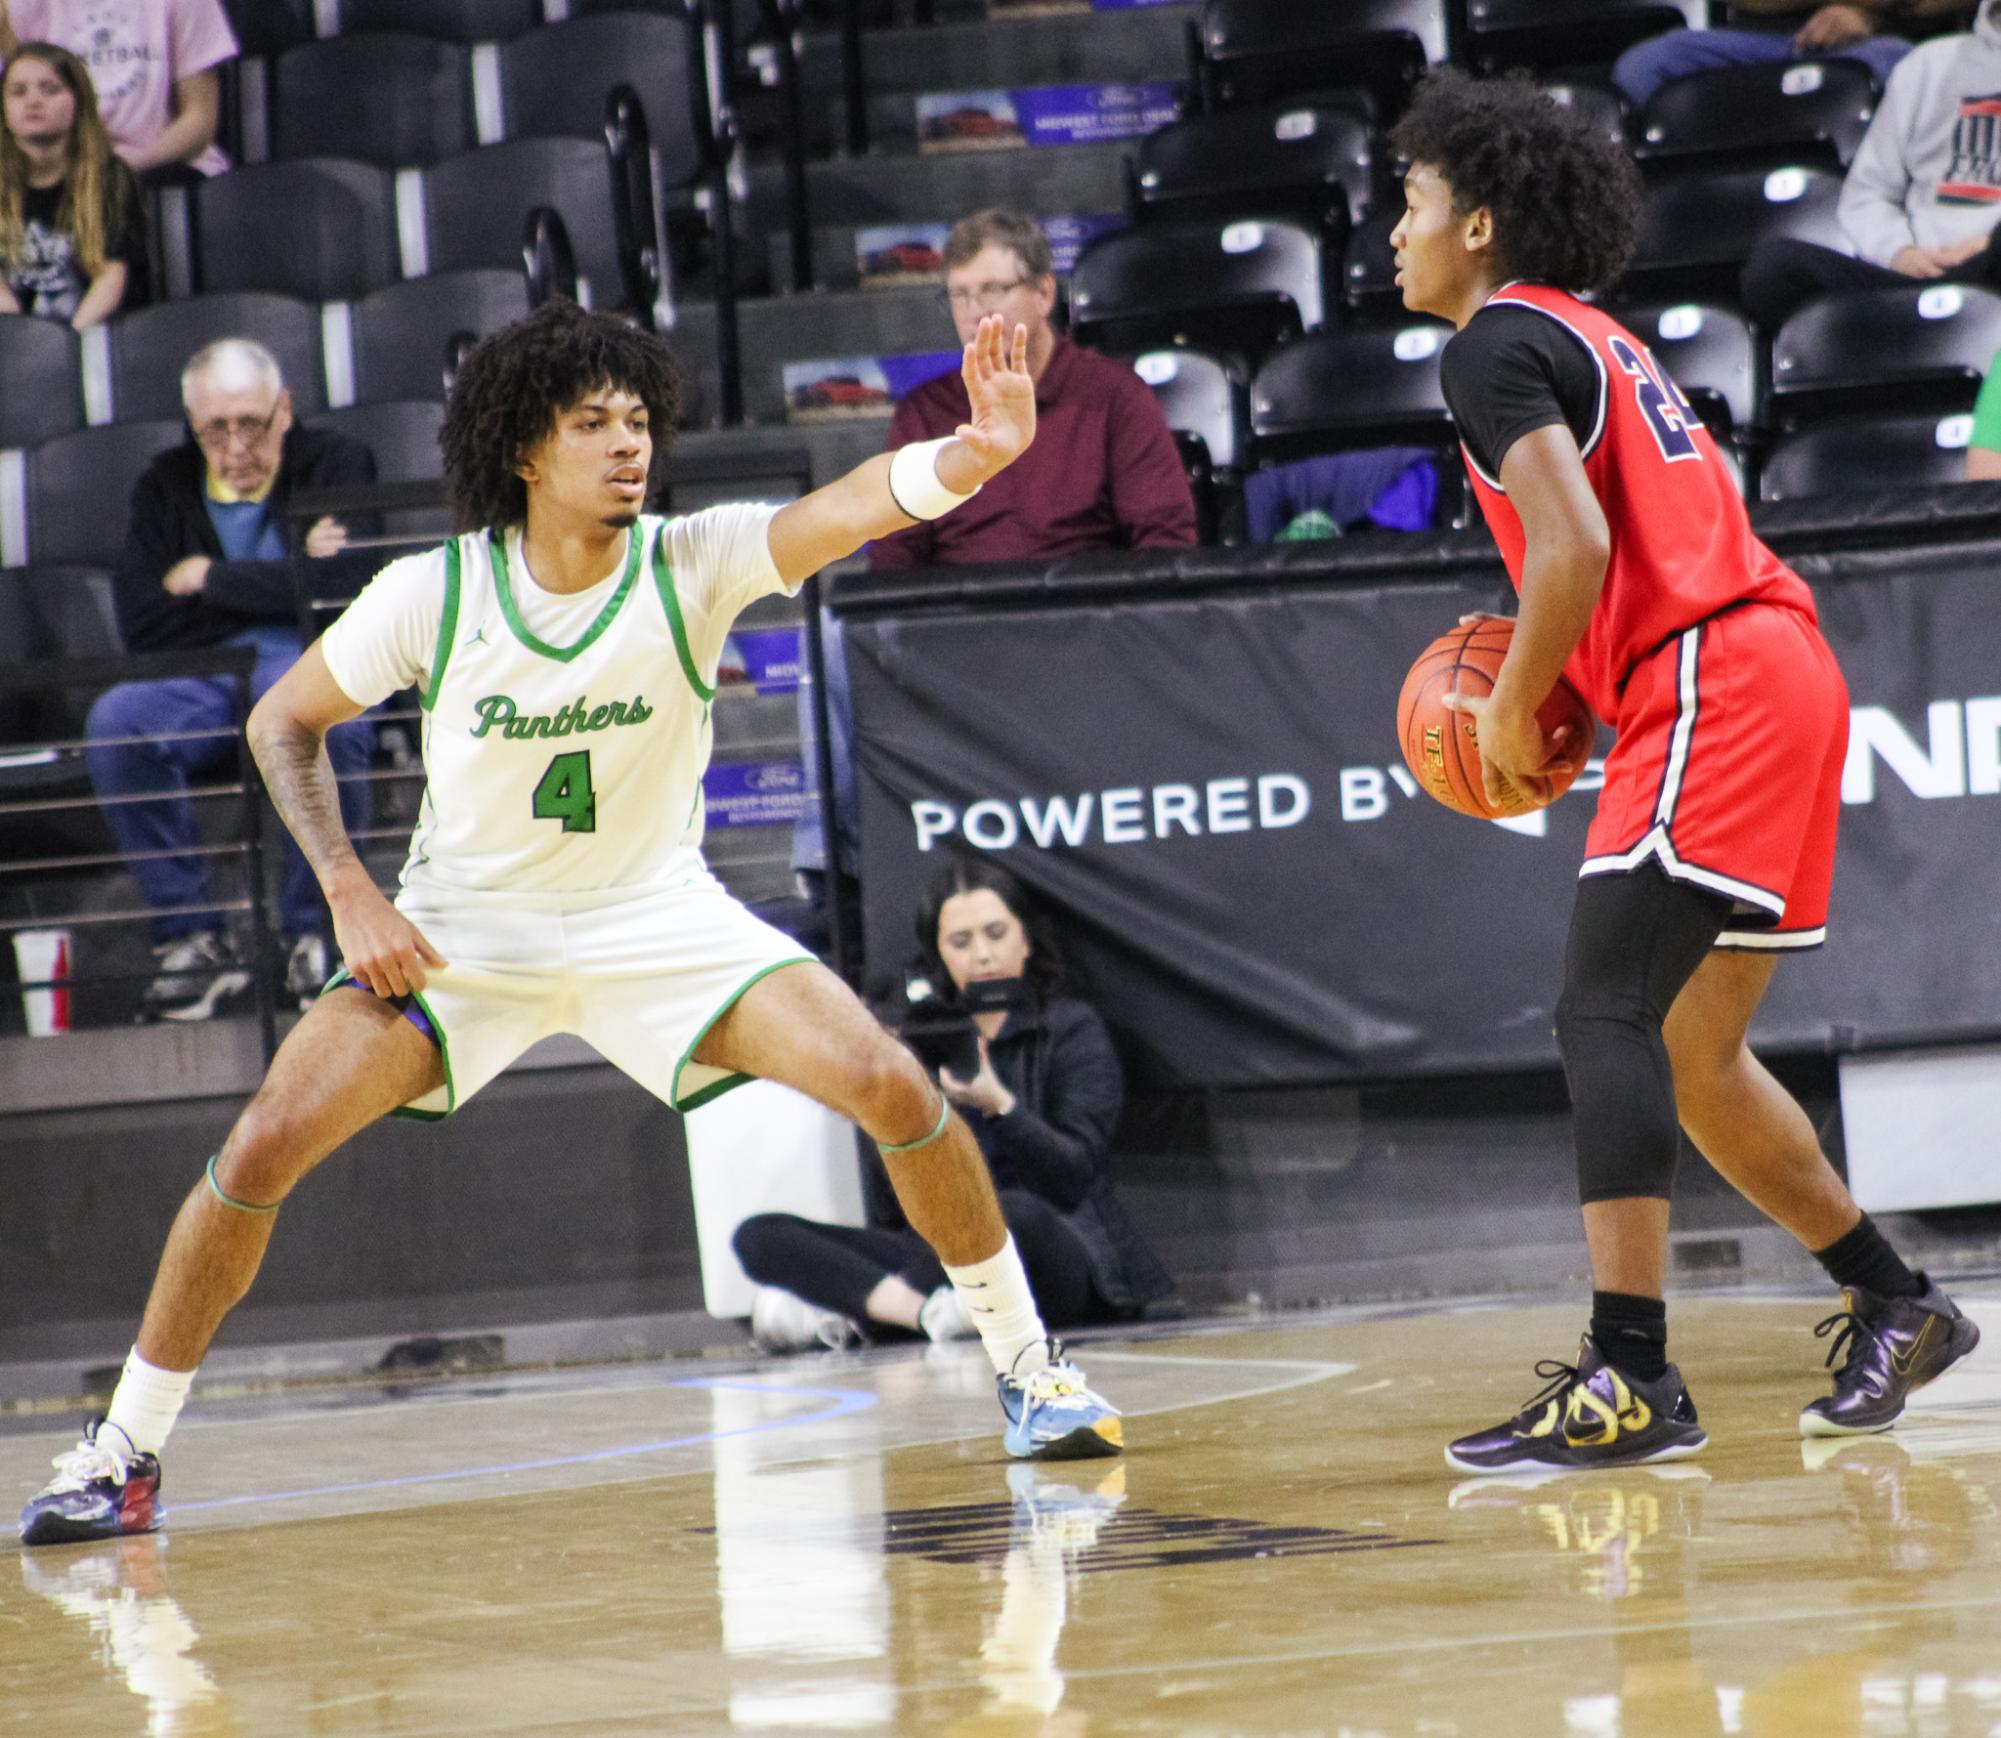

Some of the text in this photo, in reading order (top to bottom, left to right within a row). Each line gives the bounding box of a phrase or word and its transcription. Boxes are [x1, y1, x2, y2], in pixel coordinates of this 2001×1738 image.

[469, 694, 654, 740] Panthers
[532, 748, 597, 834] 4
[911, 773, 1311, 852] POWERED
